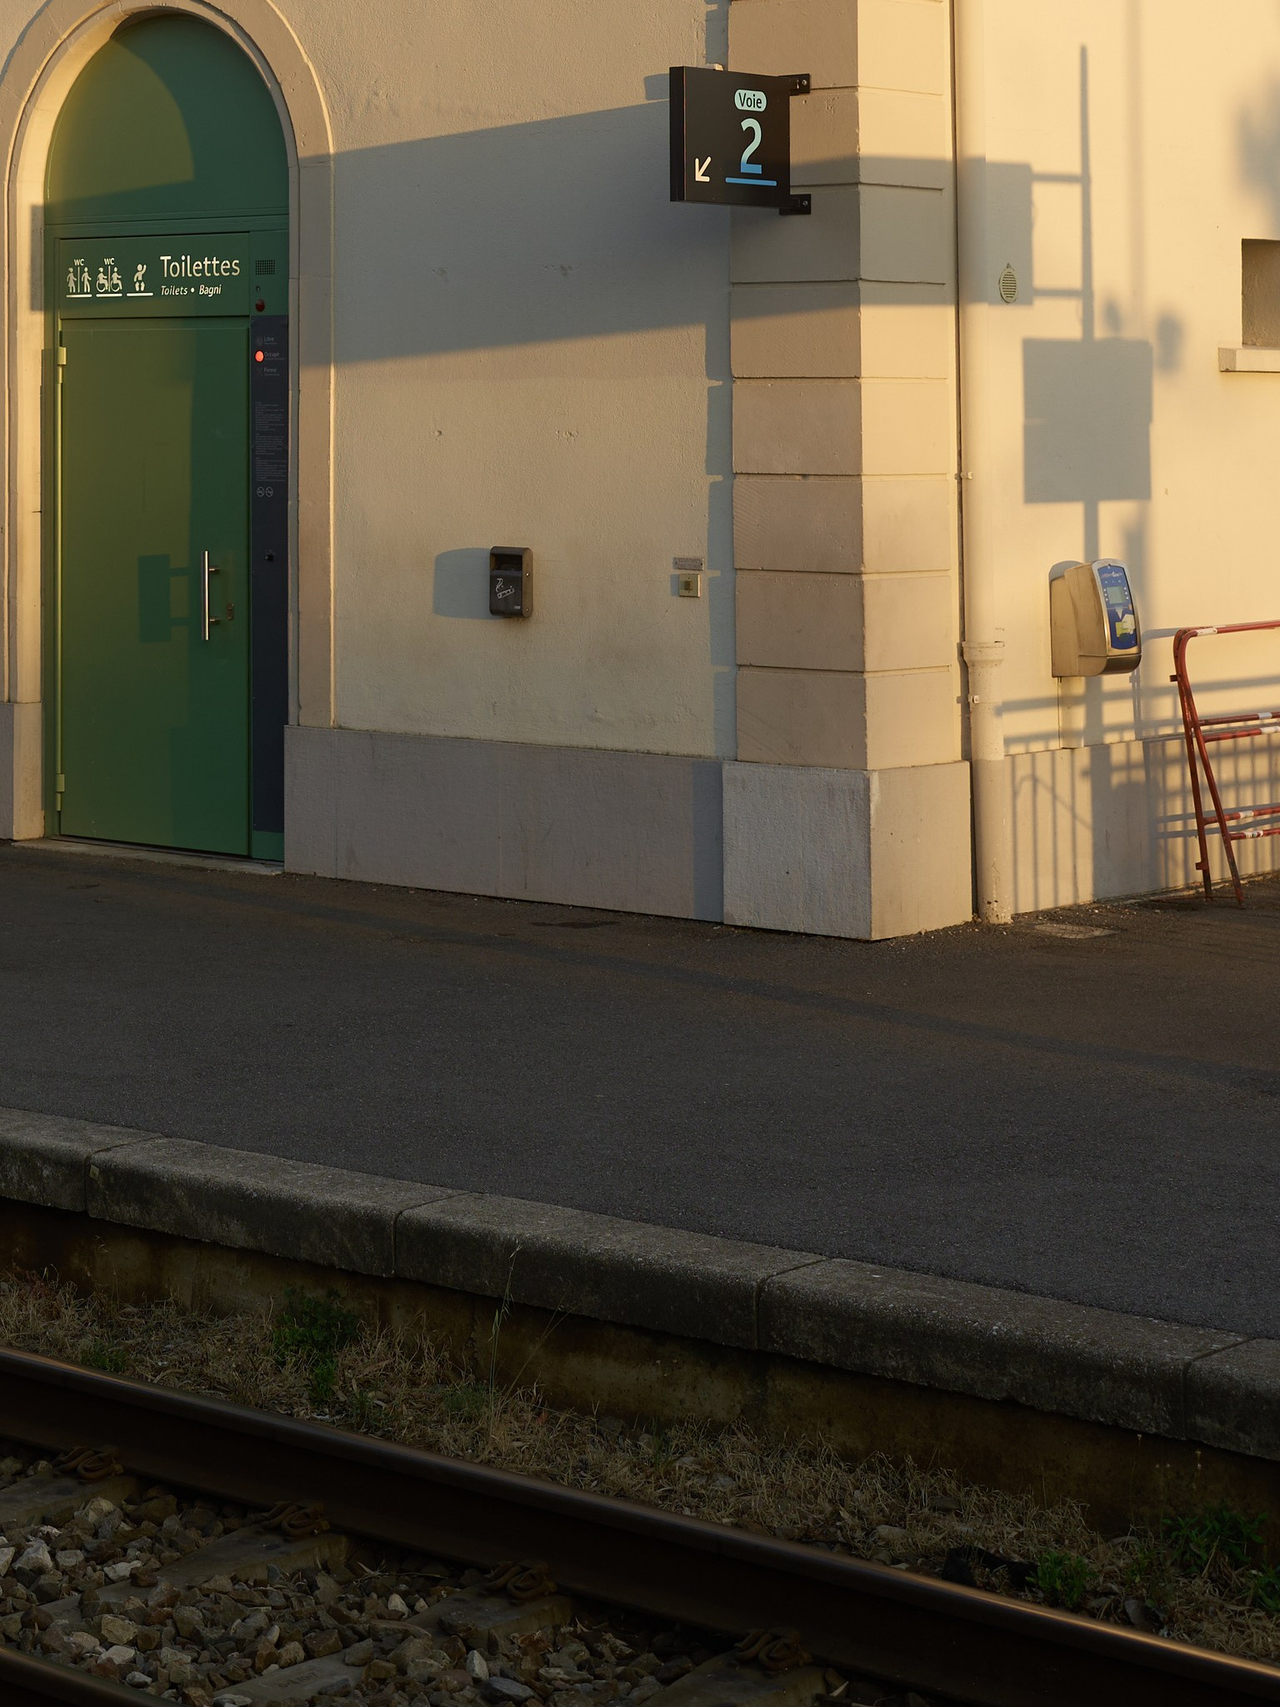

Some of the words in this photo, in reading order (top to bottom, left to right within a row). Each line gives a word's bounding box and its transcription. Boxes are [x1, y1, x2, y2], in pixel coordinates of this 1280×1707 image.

[738, 92, 763, 109] Voie
[740, 117, 763, 175] 2
[159, 255, 241, 278] Toilettes
[160, 285, 188, 295] Toilets
[198, 284, 222, 297] Bagni
